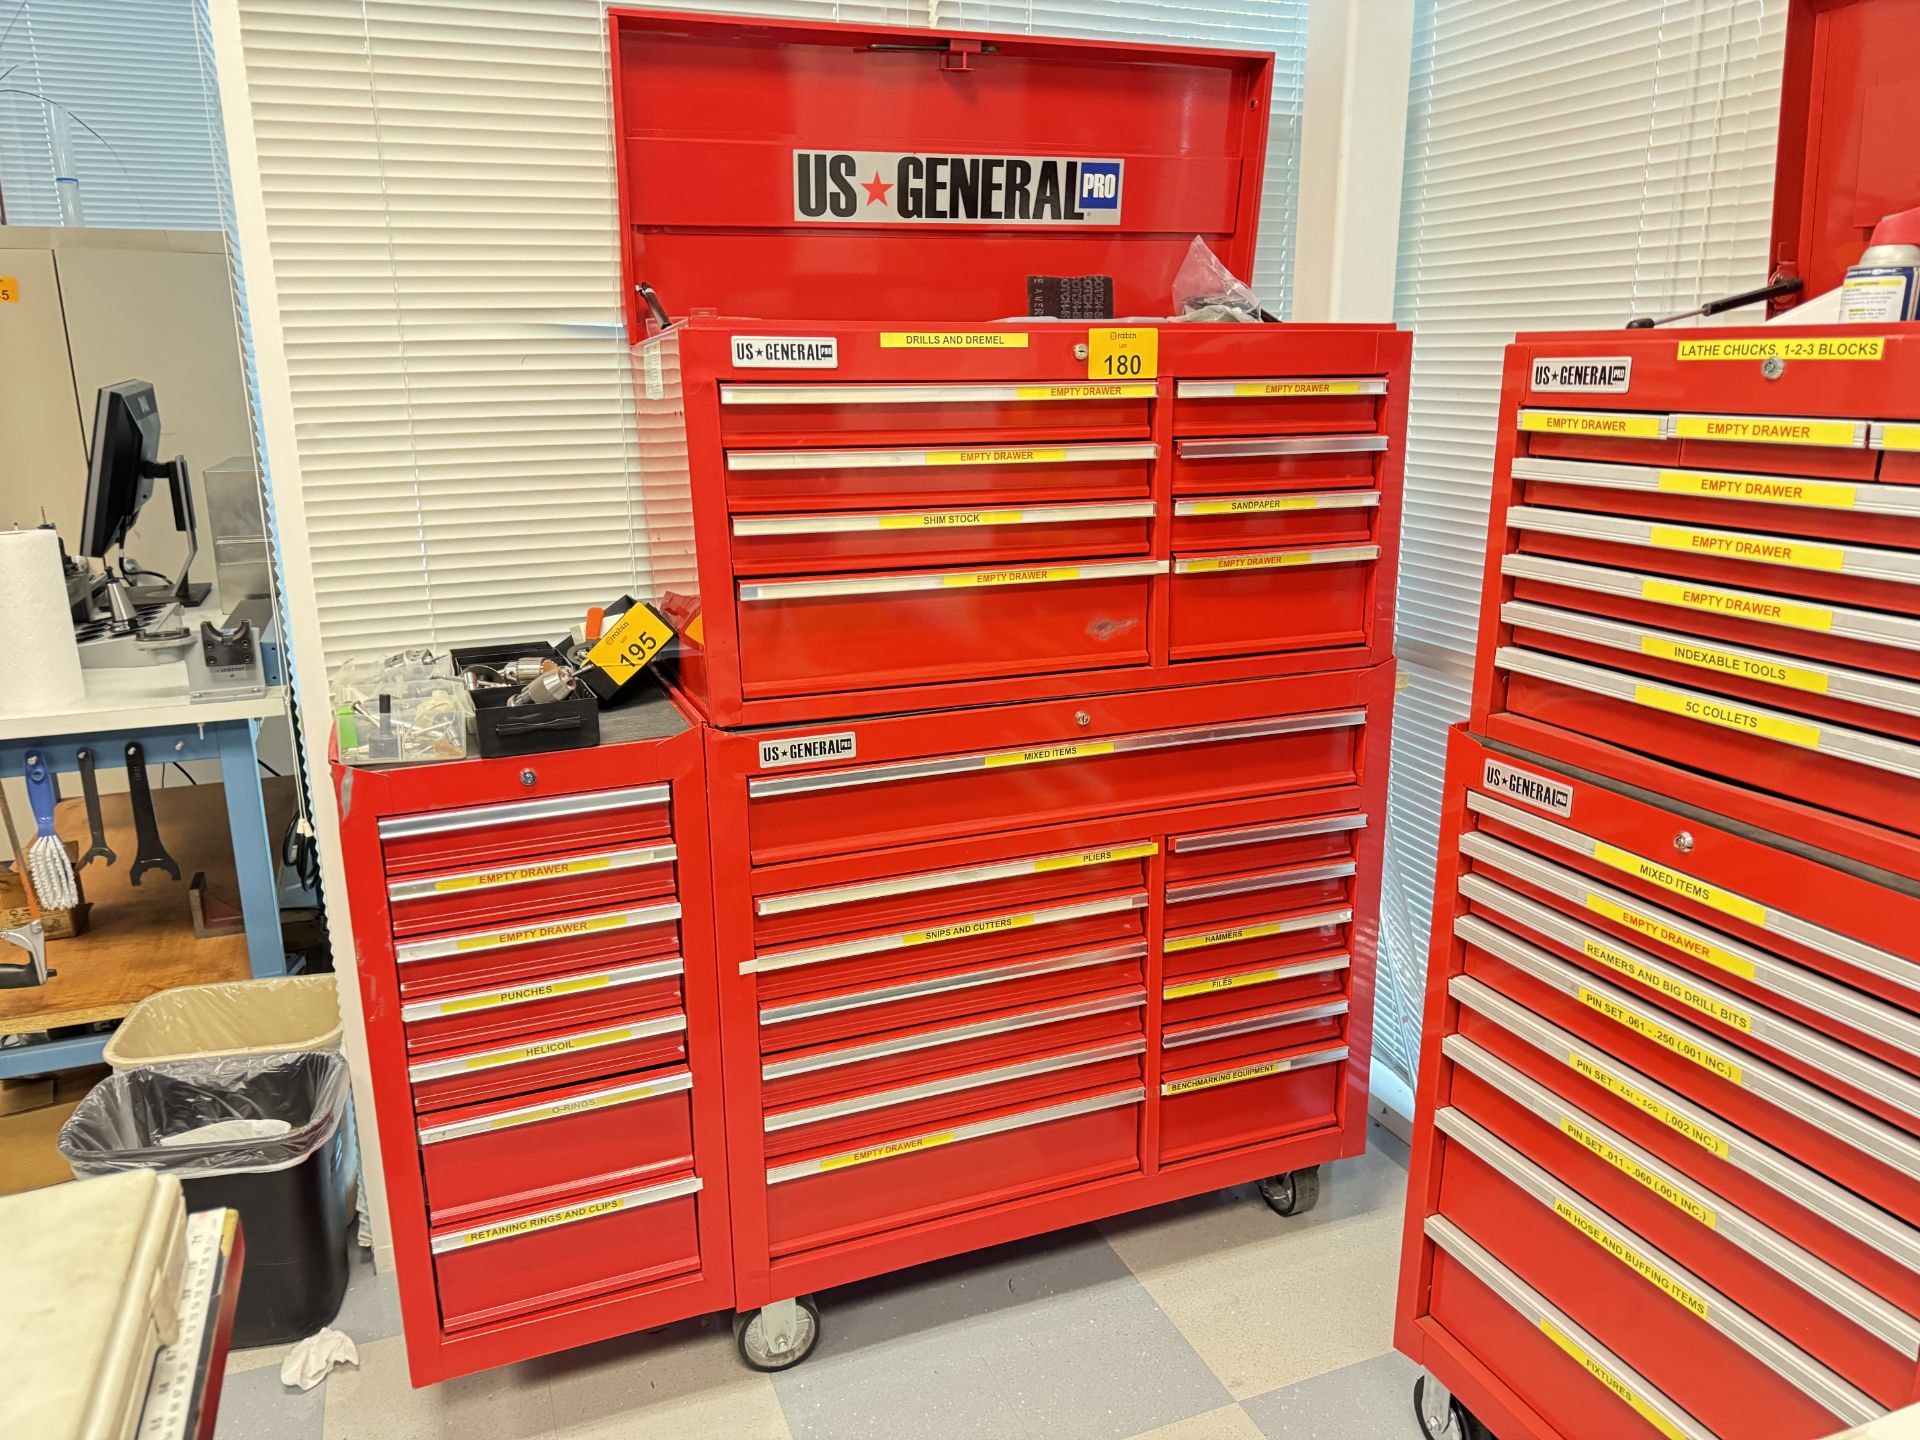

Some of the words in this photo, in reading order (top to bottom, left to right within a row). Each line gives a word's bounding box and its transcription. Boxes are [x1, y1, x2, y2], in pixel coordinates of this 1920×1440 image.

[798, 154, 856, 217] US
[897, 156, 1085, 220] GENERAL
[1083, 173, 1115, 199] PRO
[906, 335, 940, 346] DRILLS
[942, 335, 962, 346] AND
[965, 334, 1004, 345] DREMEL
[1681, 342, 1720, 356] LATHE
[1723, 342, 1778, 357] CHUCKS,
[1783, 344, 1814, 356] 1-2-3
[1818, 343, 1878, 355] BLOCKS
[736, 344, 758, 360] US
[765, 343, 822, 362] GENERAL
[1105, 355, 1141, 375] 180
[1535, 366, 1551, 385] US
[1560, 366, 1614, 386] GENERAL
[1051, 387, 1082, 396] EMPTY
[1084, 387, 1122, 396] DRAWER
[1265, 384, 1293, 393] EMPTY
[1294, 384, 1330, 392] DRAWER
[1547, 418, 1579, 430] EMPTY
[1582, 419, 1626, 432] DRAWER
[1707, 423, 1748, 436] EMPTY
[1751, 424, 1810, 438] DRAWER
[960, 452, 992, 461] EMPTY
[994, 451, 1033, 460] DRAWER
[1701, 479, 1742, 494] EMPTY
[1745, 483, 1802, 498] DRAWER
[1232, 500, 1280, 510] SANDPAPER
[923, 515, 948, 525] SHIM
[949, 513, 980, 524] STOCK
[1692, 536, 1732, 552] EMPTY
[1736, 542, 1791, 560] DRAWER
[1218, 557, 1247, 568] EMPTY
[1248, 556, 1282, 566] DRAWER
[977, 572, 1009, 583] EMPTY
[1010, 571, 1047, 581] DRAWER
[1683, 592, 1723, 608] EMPTY
[1726, 598, 1780, 618] DRAWER
[620, 632, 656, 668] 195
[1674, 648, 1740, 670] INDEXABLE
[1744, 660, 1785, 680] TOOLS
[1686, 702, 1699, 714] 5C
[1702, 705, 1757, 728] COLLETS
[764, 747, 777, 760] US
[790, 740, 842, 759] GENERAL
[1024, 750, 1049, 760] MIXED
[1052, 747, 1076, 757] ITEMS
[1487, 766, 1500, 785] US
[1510, 775, 1557, 807] GENERAL
[1083, 852, 1111, 863] PLIERS
[480, 869, 518, 884] EMPTY
[521, 864, 569, 880] DRAWER
[1640, 864, 1673, 886] MIXED
[1676, 880, 1709, 900] ITEMS
[500, 928, 538, 942] EMPTY
[540, 922, 587, 937] DRAWER
[925, 929, 952, 939] SNIPS
[954, 925, 969, 936] AND
[972, 919, 1012, 933] CUTTERS
[1205, 930, 1243, 943] HAMMERS
[1623, 912, 1658, 936] EMPTY
[1660, 929, 1709, 958] DRAWER
[1212, 978, 1233, 988] FILES
[1587, 944, 1635, 974] REAMERS
[1638, 970, 1660, 986] AND
[1663, 981, 1680, 996] BIG
[1684, 990, 1716, 1013] DRILL
[1720, 1007, 1747, 1028] BITS
[501, 985, 552, 1003] PUNCHES
[1586, 994, 1602, 1008] PIN
[1605, 1003, 1624, 1020] SET
[1626, 1016, 1645, 1031] .061
[1654, 1030, 1675, 1046] .250
[1677, 1041, 1702, 1062] (.001
[1705, 1056, 1731, 1078] INC.)
[526, 1039, 575, 1057] HELICOIL
[1171, 1072, 1230, 1091] BENCHMARKING
[1232, 1065, 1274, 1080] EQUIPMENT
[551, 1098, 595, 1115] O-RINGS
[1576, 1060, 1592, 1075] PIN
[1595, 1070, 1613, 1086] SET
[1665, 1113, 1690, 1134] (.002
[1692, 1130, 1718, 1152] INC.)
[854, 1148, 883, 1162] EMPTY
[885, 1139, 923, 1155] DRAWER
[1568, 1124, 1584, 1141] PIN
[1586, 1135, 1603, 1152] SET
[1605, 1150, 1624, 1168] .011
[1632, 1169, 1652, 1187] .060
[1655, 1180, 1677, 1202] (.001
[1680, 1197, 1706, 1221] INC.)
[471, 1222, 527, 1241] RETAINING
[530, 1214, 562, 1231] RINGS
[564, 1210, 584, 1223] AND
[587, 1201, 618, 1218] CLIPS
[1556, 1202, 1572, 1219] AIR
[1575, 1215, 1600, 1238] HOSE
[1602, 1236, 1622, 1254] AND
[1625, 1251, 1669, 1288] BUFFING
[1672, 1285, 1704, 1312] ITEMS
[1585, 1358, 1632, 1402] FIXTURES
